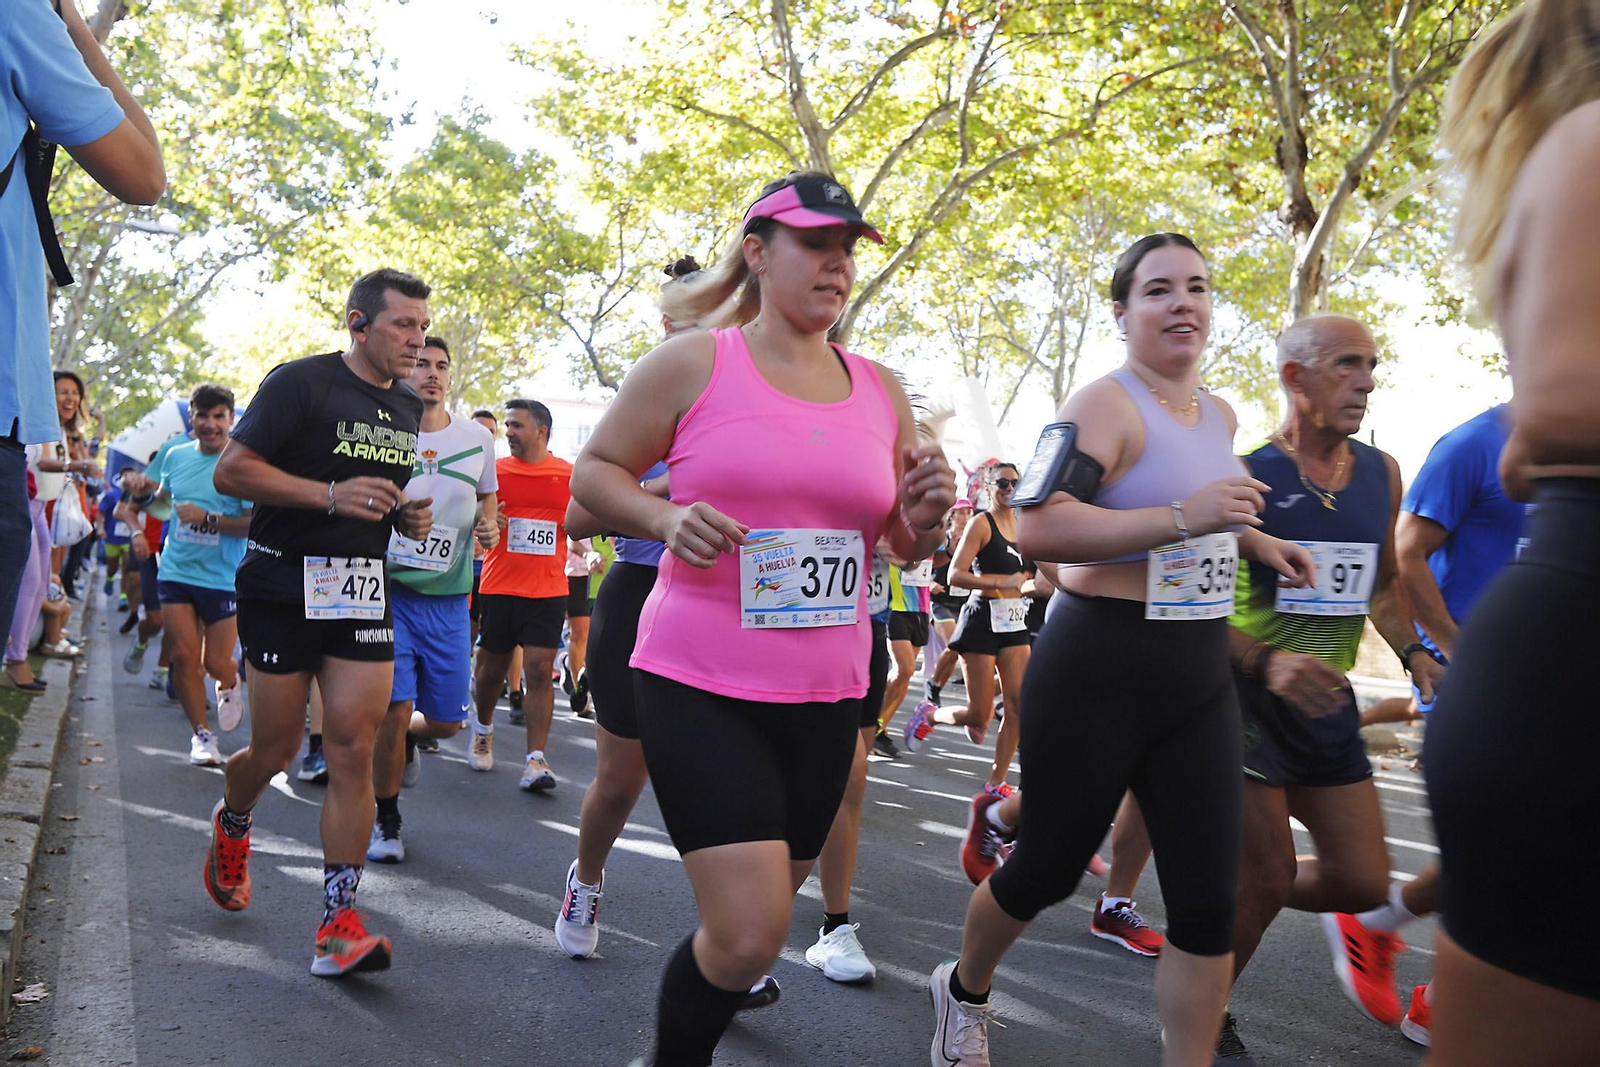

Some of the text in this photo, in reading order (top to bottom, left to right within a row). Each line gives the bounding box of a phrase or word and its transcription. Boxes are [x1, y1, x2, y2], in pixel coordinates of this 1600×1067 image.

[336, 421, 417, 451] UNDER
[332, 440, 416, 467] ARMOUR
[415, 537, 452, 558] 378
[527, 529, 554, 546] 456
[815, 536, 848, 546] BEATRIZ
[752, 546, 795, 563] 35 VUELTA
[758, 557, 797, 573] A HUELVA
[341, 574, 382, 602] 472
[800, 556, 858, 598] 370
[1331, 563, 1363, 594] 97
